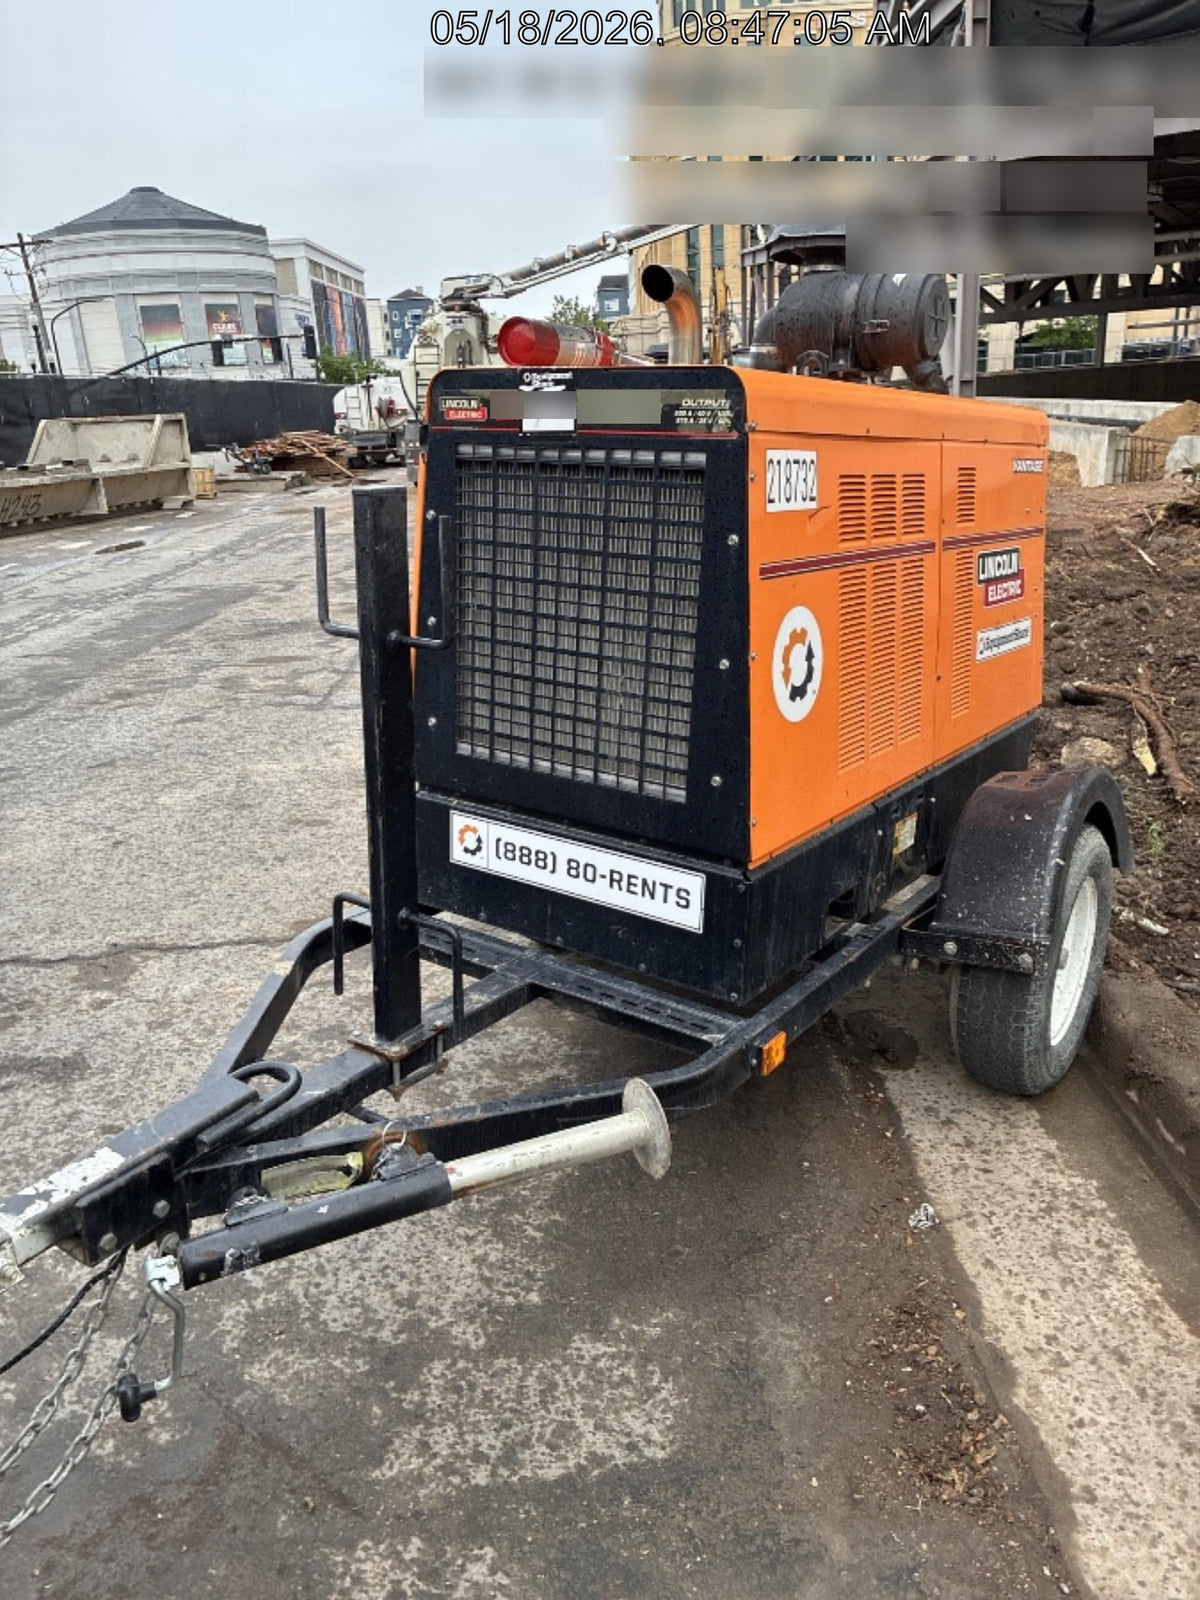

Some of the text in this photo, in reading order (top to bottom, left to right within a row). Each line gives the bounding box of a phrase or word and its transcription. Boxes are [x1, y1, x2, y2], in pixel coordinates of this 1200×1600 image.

[441, 399, 478, 409] LINCOLN
[682, 398, 727, 407] OUTPUT
[767, 458, 817, 504] 218732
[979, 552, 1018, 582] LINCOLN
[987, 578, 1022, 602] ELECTRIC
[496, 838, 691, 909] (888) 80-RENTS
